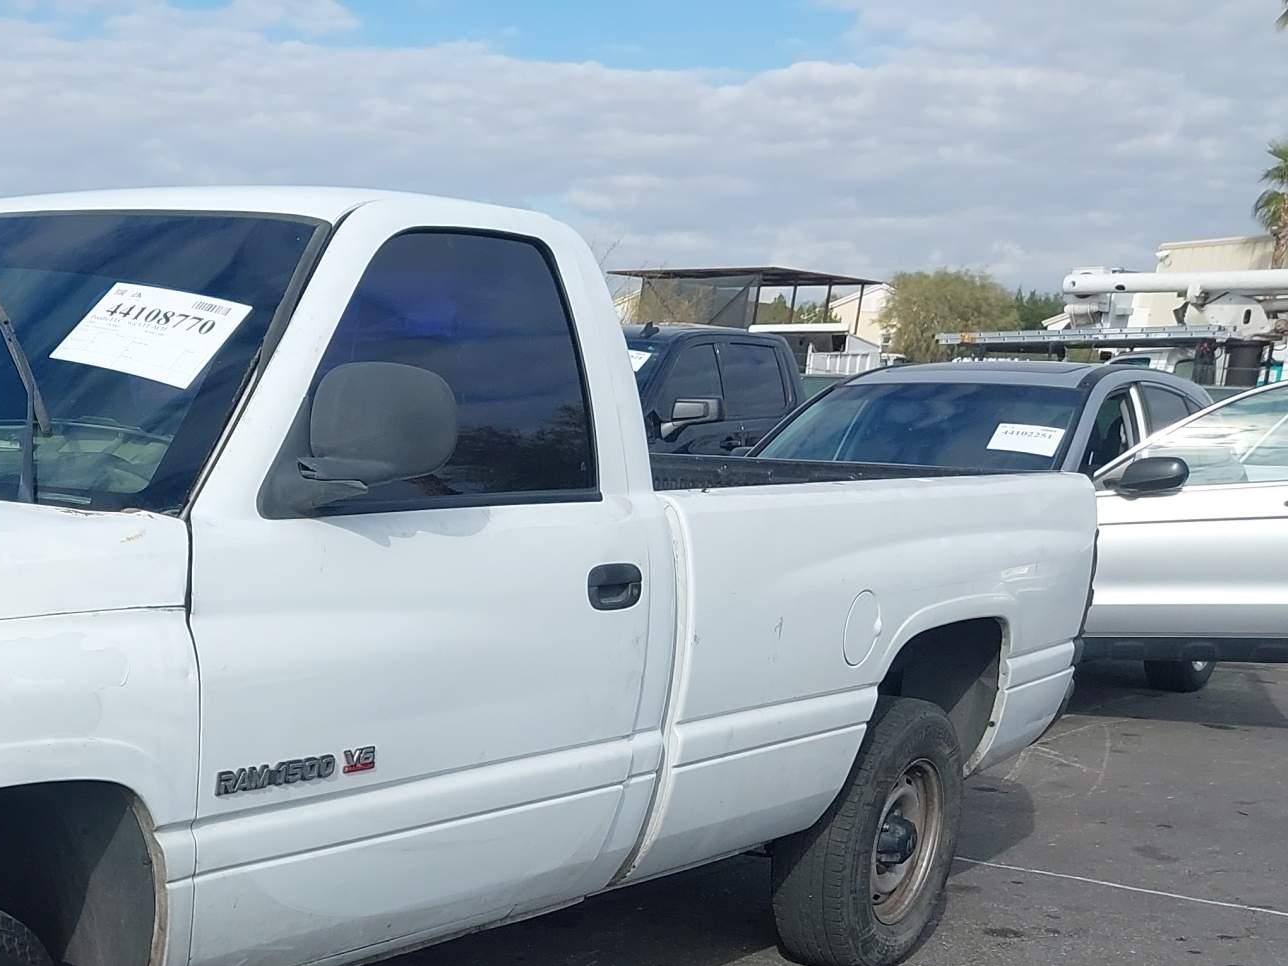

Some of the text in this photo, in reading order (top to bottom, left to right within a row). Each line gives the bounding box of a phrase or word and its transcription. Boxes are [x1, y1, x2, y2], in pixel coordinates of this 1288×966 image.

[105, 302, 216, 335] 44108770
[214, 746, 376, 796] RAM 1500 V6
